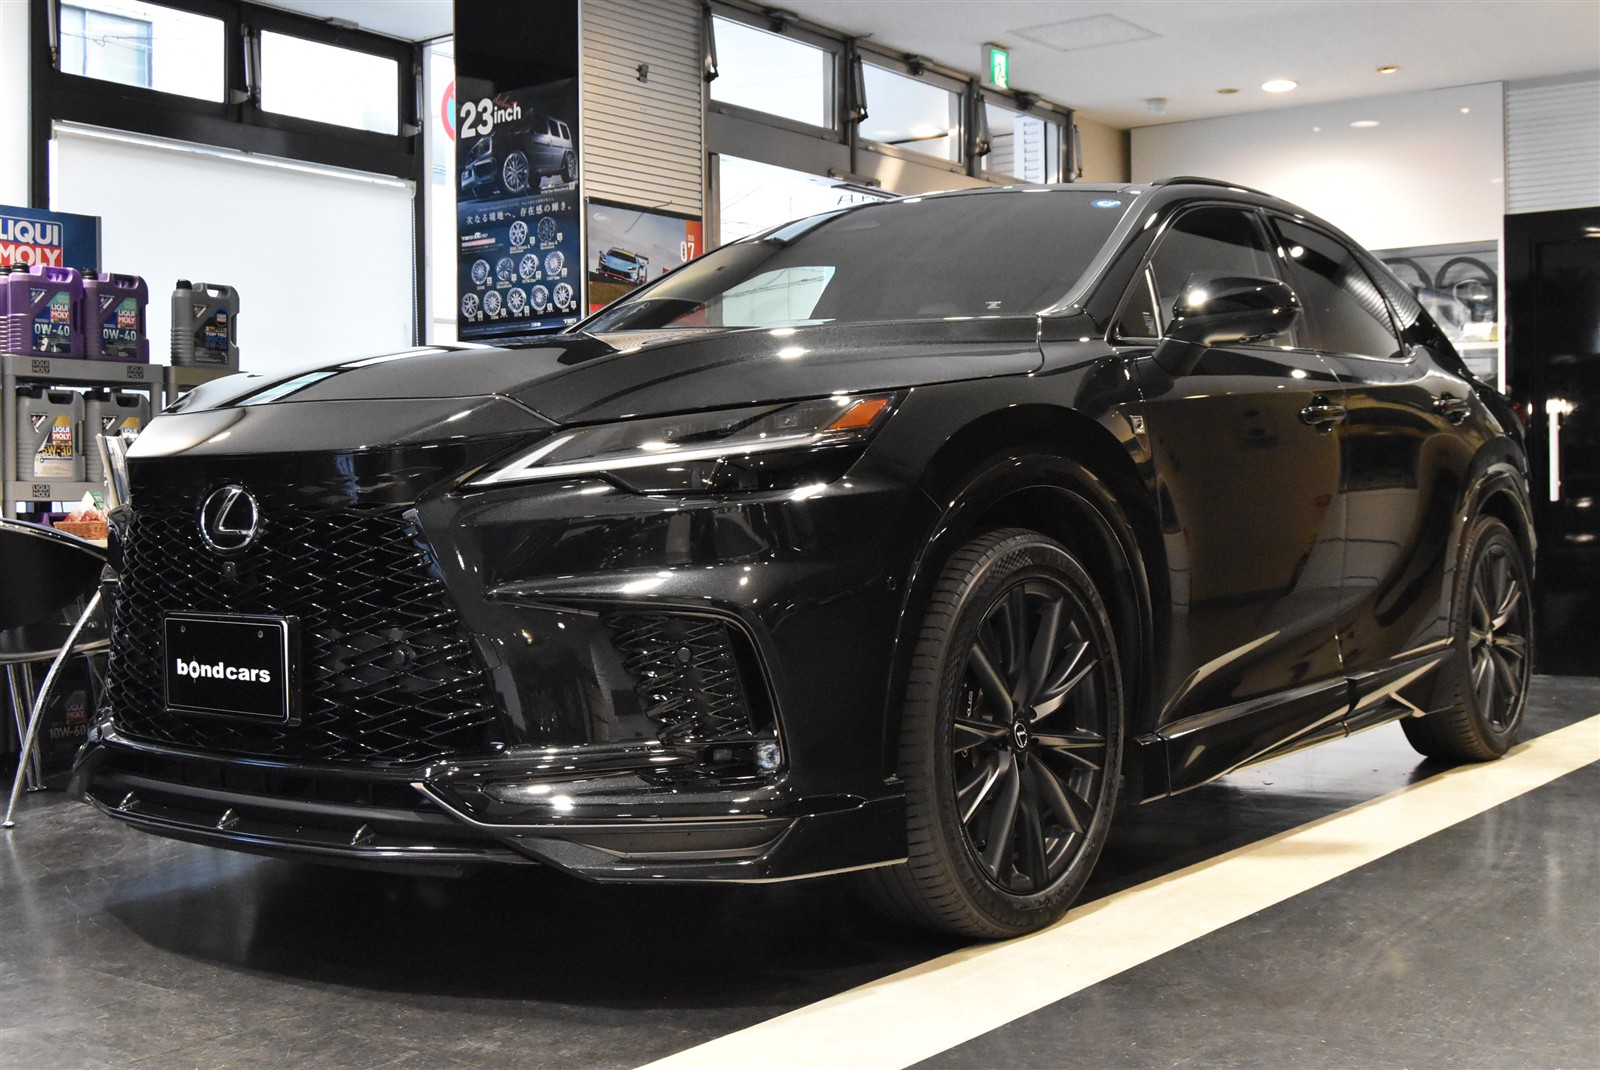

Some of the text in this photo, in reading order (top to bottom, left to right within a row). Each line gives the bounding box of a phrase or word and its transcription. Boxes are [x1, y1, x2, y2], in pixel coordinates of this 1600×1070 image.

[0, 218, 59, 246] LIQUI
[0, 243, 61, 267] MOLY
[51, 303, 69, 311] LIQUI
[51, 310, 70, 319] MOLY
[34, 323, 70, 336] 0W-40
[102, 328, 137, 341] 0W-40
[52, 432, 71, 441] MOLY
